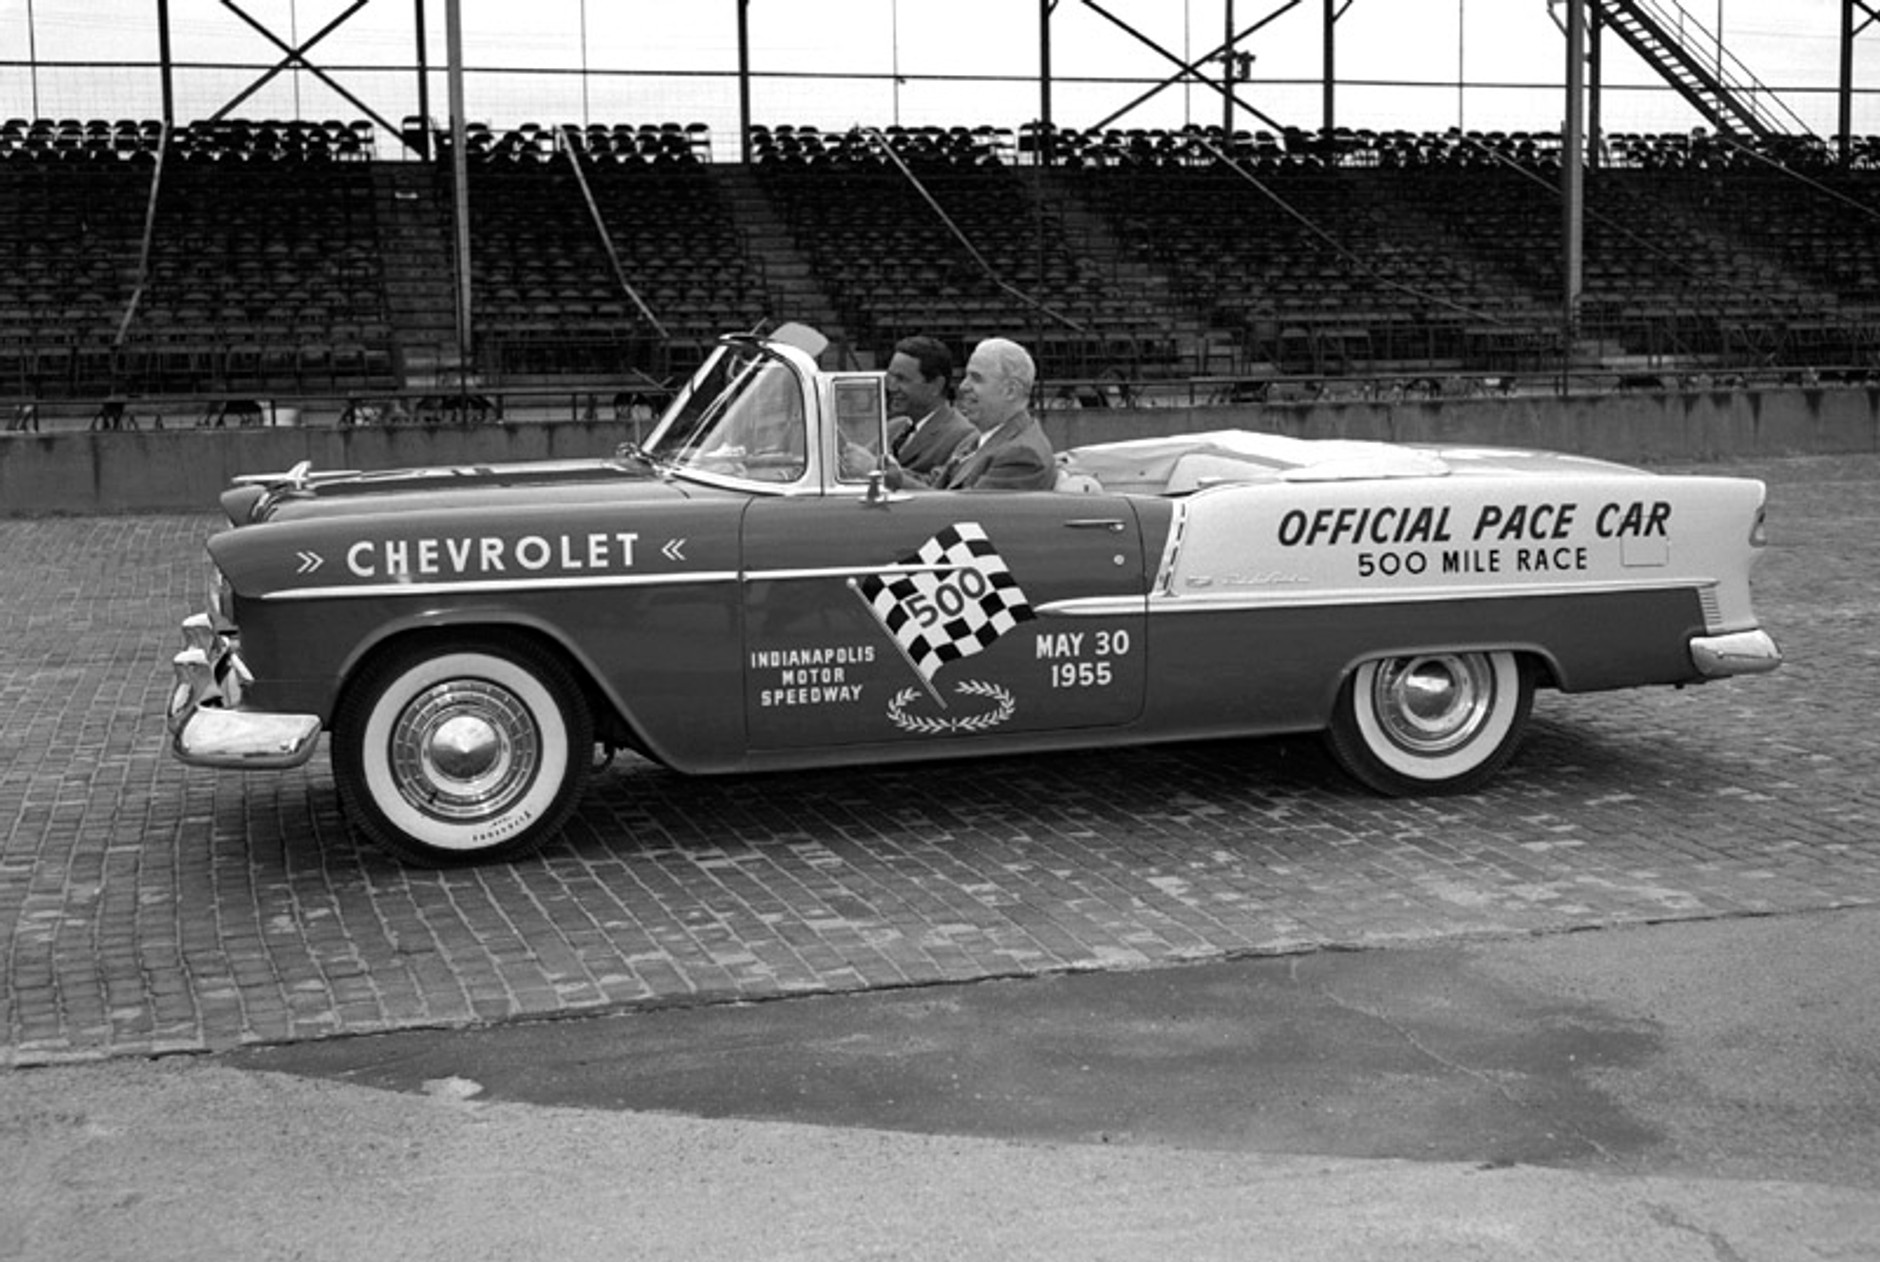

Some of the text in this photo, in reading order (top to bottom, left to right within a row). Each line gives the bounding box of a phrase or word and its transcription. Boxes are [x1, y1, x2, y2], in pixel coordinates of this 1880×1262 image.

[1278, 501, 1672, 547] OFFICIAL PACE CAR
[346, 533, 639, 577] CHEVROLET
[1358, 547, 1587, 577] 500 MILE RACE
[905, 566, 986, 628] 500
[751, 645, 876, 669] INDIANAPOLIS
[1036, 629, 1130, 659] MAY 30
[782, 667, 845, 686] MOTOR
[1051, 661, 1112, 688] 1955
[761, 684, 863, 707] SPEEDWAY
